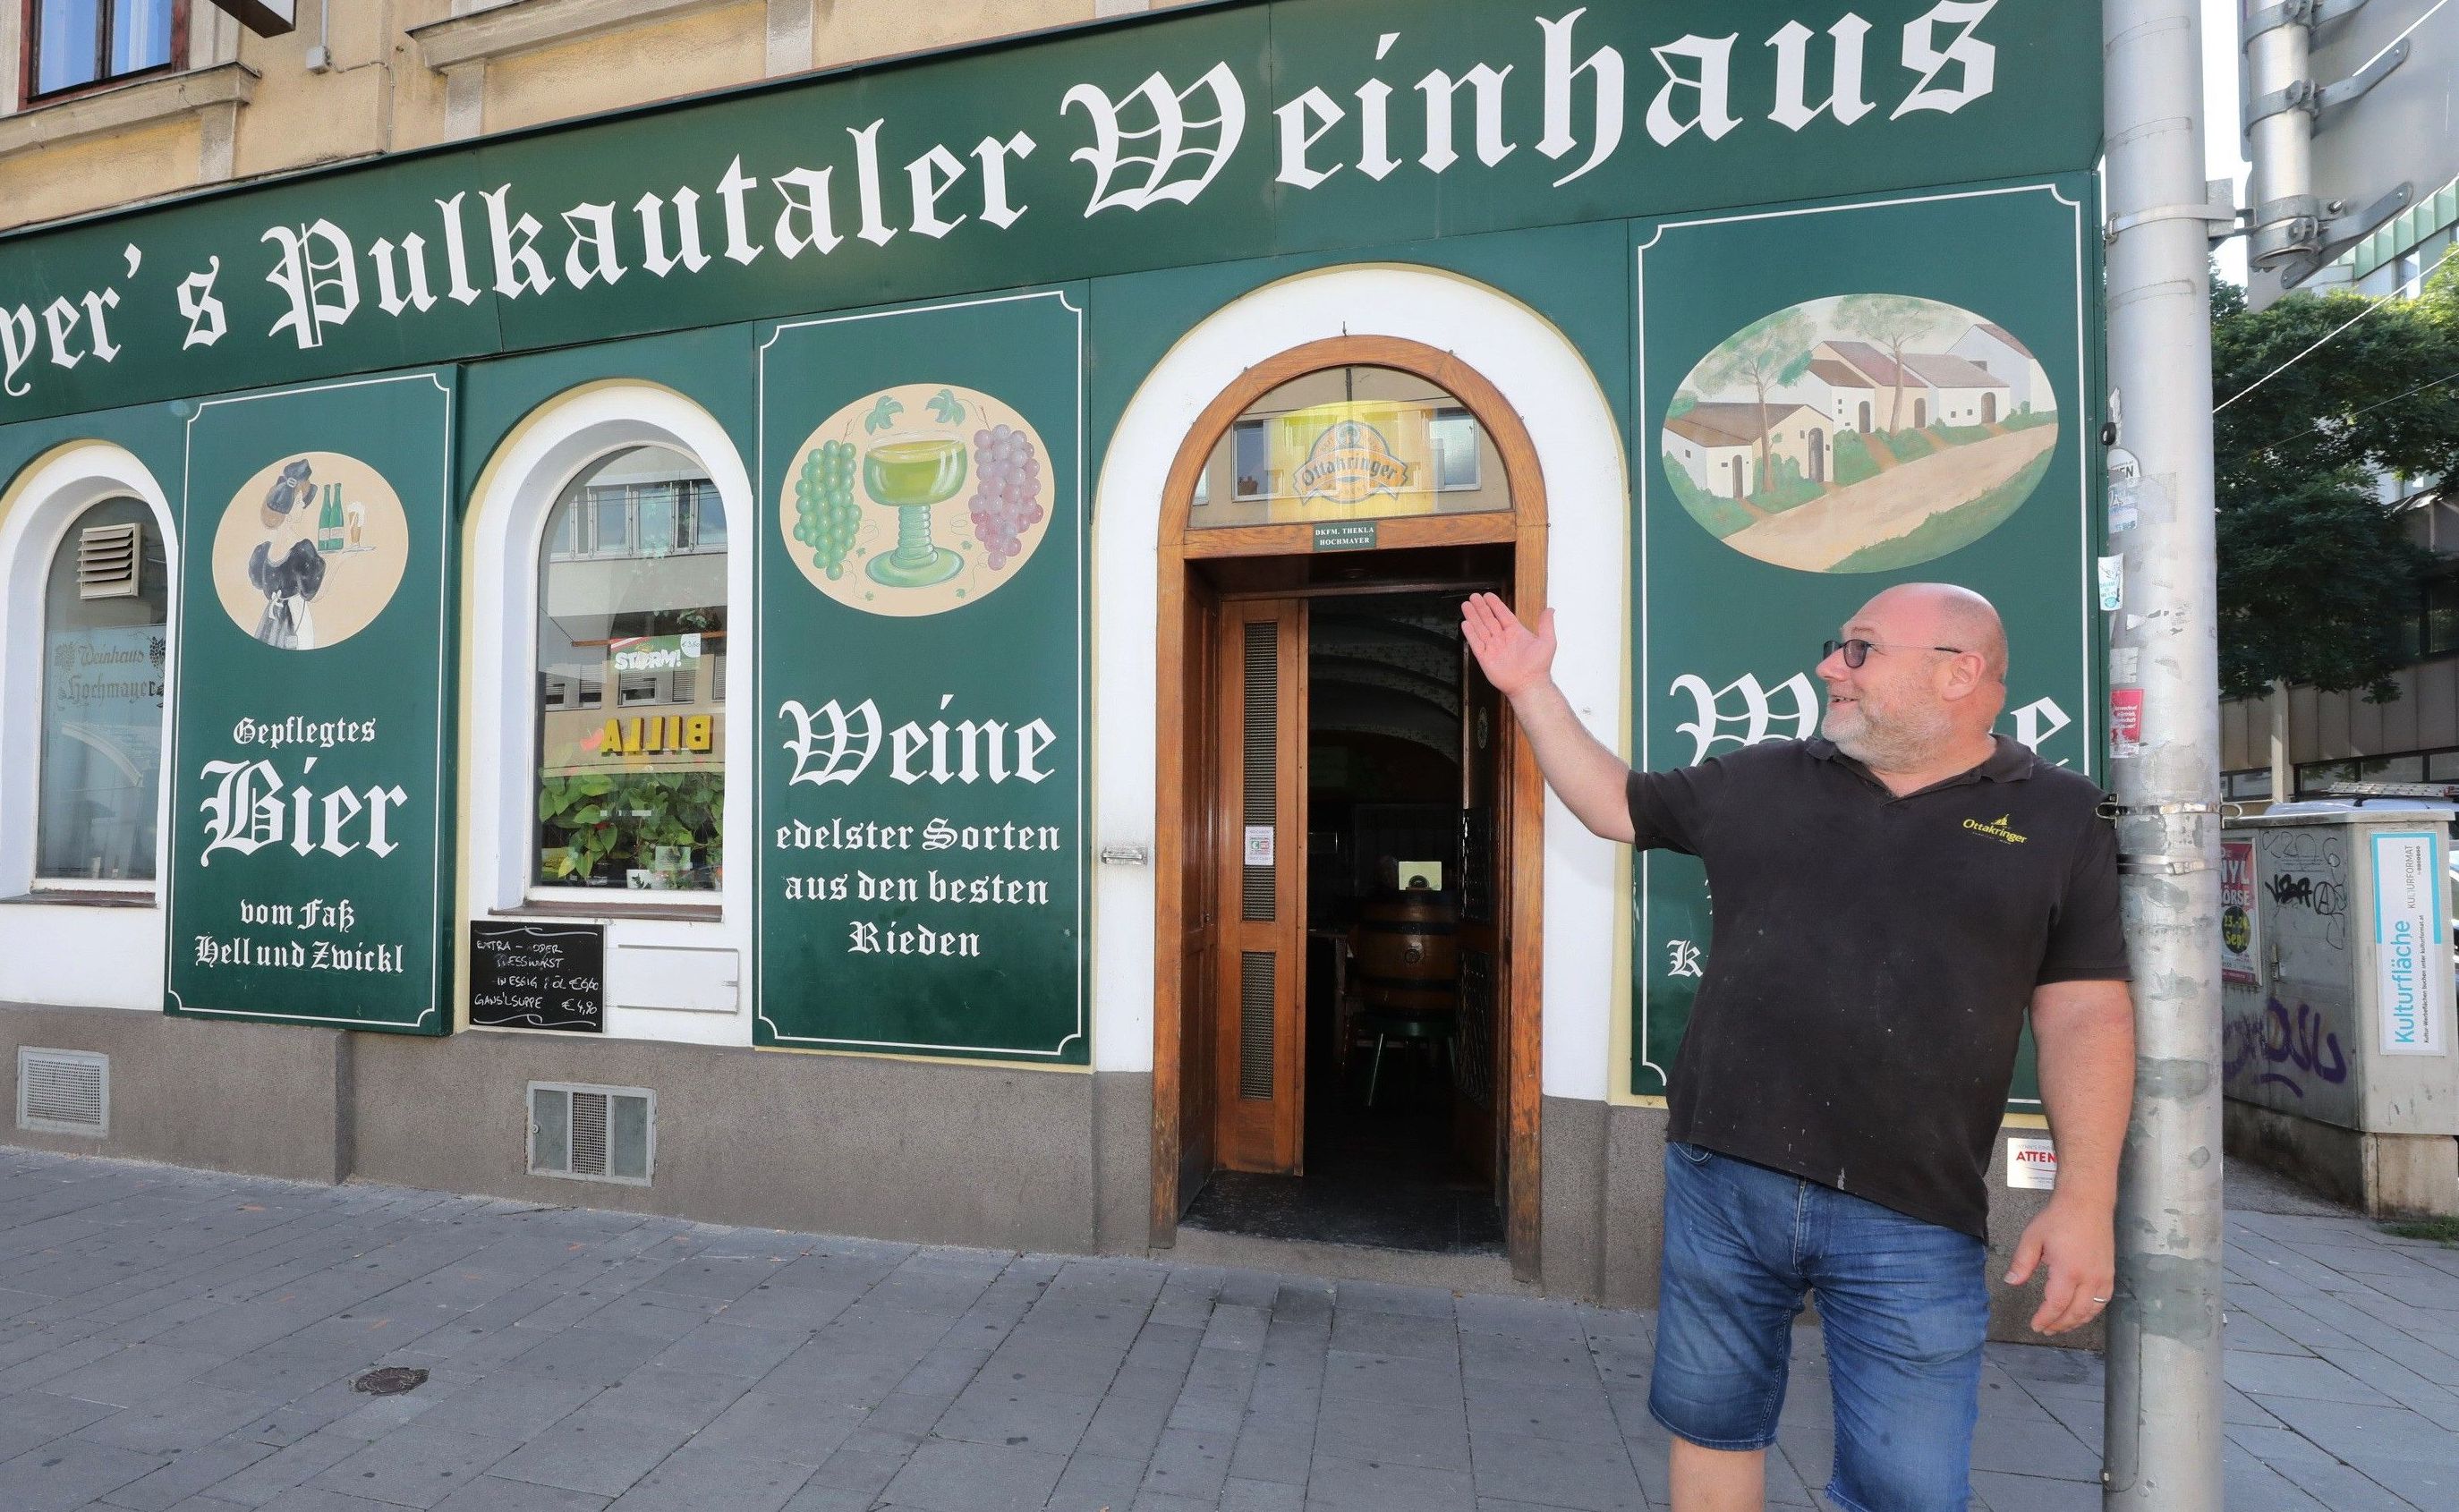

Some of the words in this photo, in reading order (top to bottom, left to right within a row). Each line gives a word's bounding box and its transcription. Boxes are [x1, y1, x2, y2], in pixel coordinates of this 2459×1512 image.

[260, 118, 1036, 349] Pulkautaler
[1060, 0, 1996, 218] Weinhaus
[1315, 527, 1340, 536] DKFM.
[1342, 526, 1374, 535] THEKLA
[1319, 537, 1370, 547] HOCHMAYER
[234, 716, 376, 749] Gepflegtes
[779, 694, 1056, 786] Weine
[200, 757, 407, 867] Bier
[777, 818, 914, 851] edelster
[922, 818, 1060, 852] Sorten
[1962, 819, 2028, 844] Ottakringer
[786, 874, 847, 902] aus
[858, 870, 918, 903] den
[928, 870, 1049, 905] besten
[241, 899, 293, 927] vom
[298, 899, 354, 933] Faß
[195, 936, 250, 968] Hell
[257, 940, 304, 969] und
[311, 941, 404, 973] Zwickl
[476, 940, 511, 951] EXTRA
[532, 944, 563, 954] ODER
[848, 921, 981, 957] Rieden
[509, 975, 538, 989] ESSIG
[2389, 920, 2415, 1044] Kulturfläche
[2016, 1151, 2057, 1163] ATTEN
